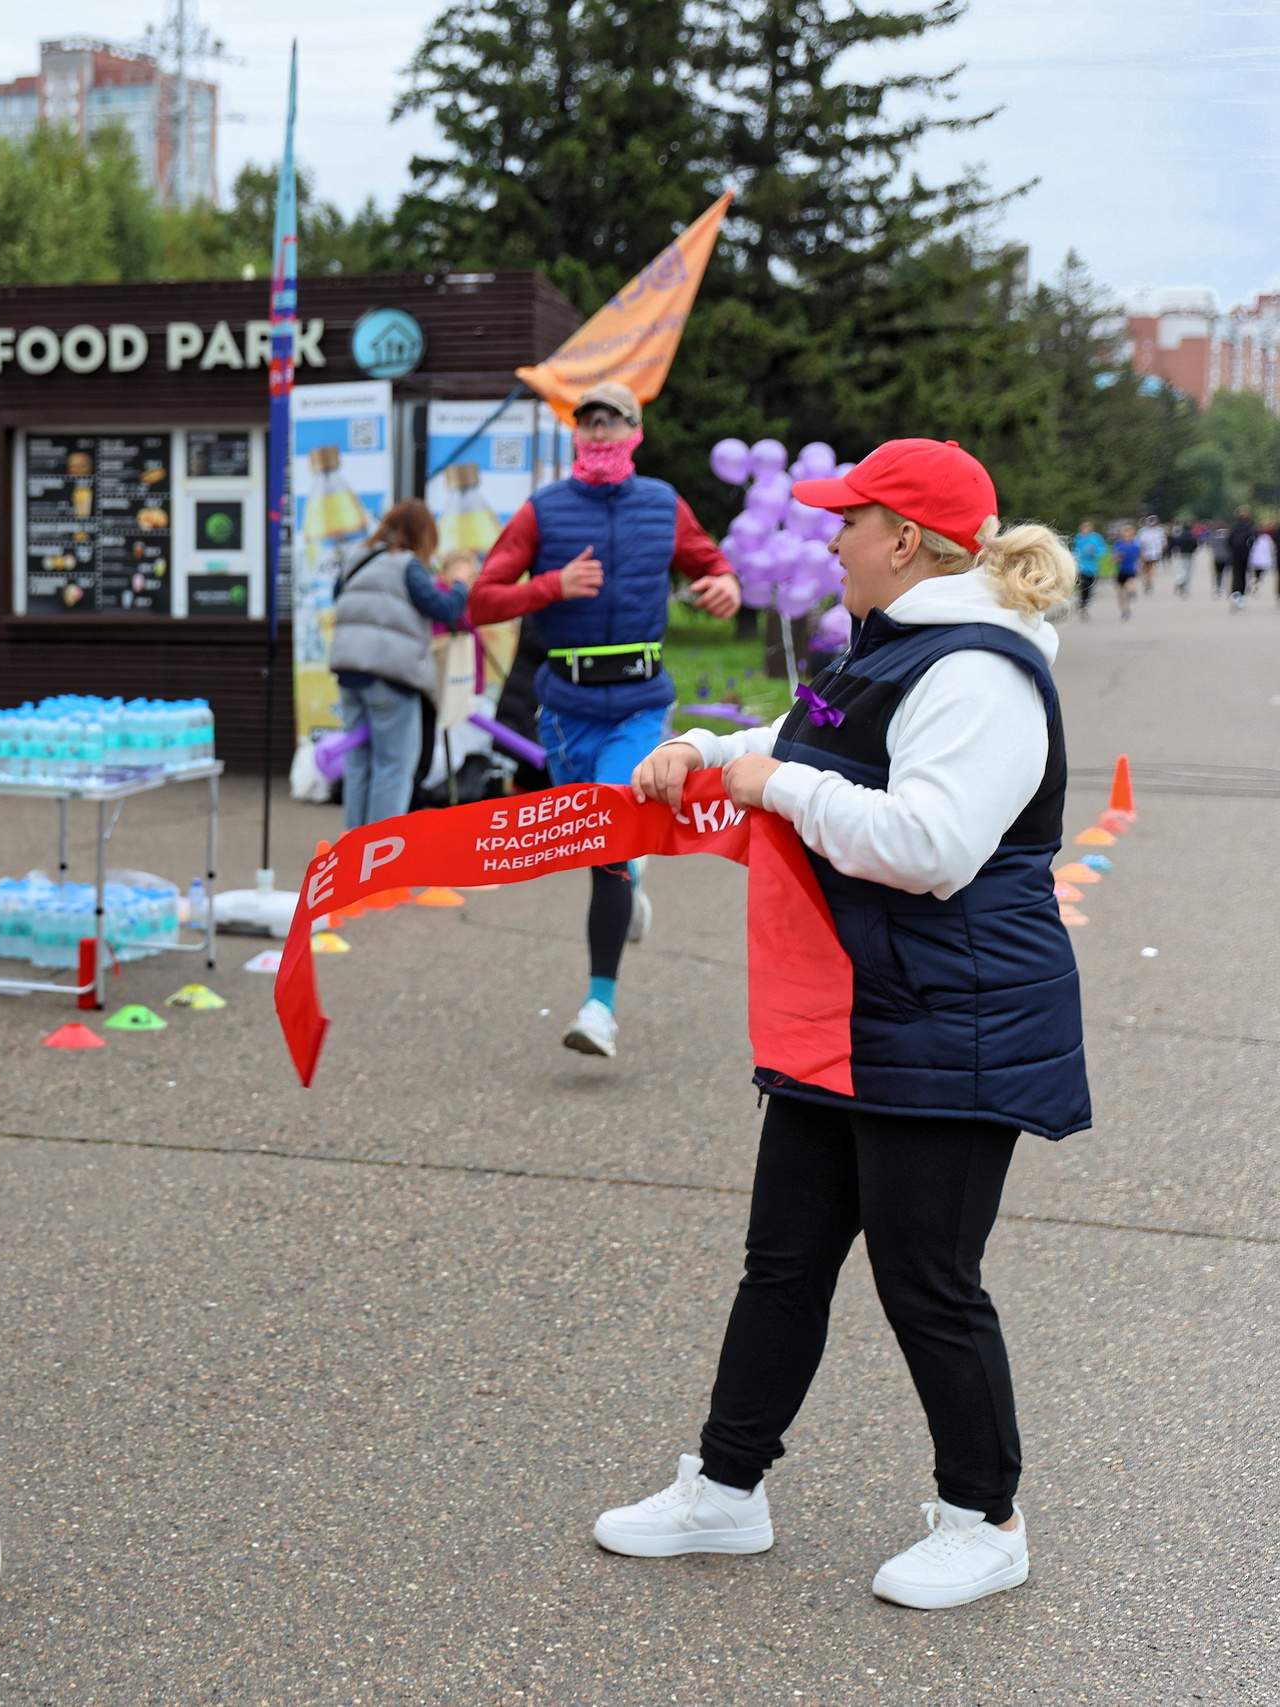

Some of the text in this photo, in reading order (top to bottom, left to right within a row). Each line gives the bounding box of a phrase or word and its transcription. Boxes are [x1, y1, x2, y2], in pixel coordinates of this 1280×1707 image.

[167, 319, 326, 371] PARK
[490, 786, 605, 830] 5 ВЁРСТ
[475, 809, 613, 852] КРАСНОЯРСК
[483, 835, 606, 871] НАБЕРЕЖНАЯ
